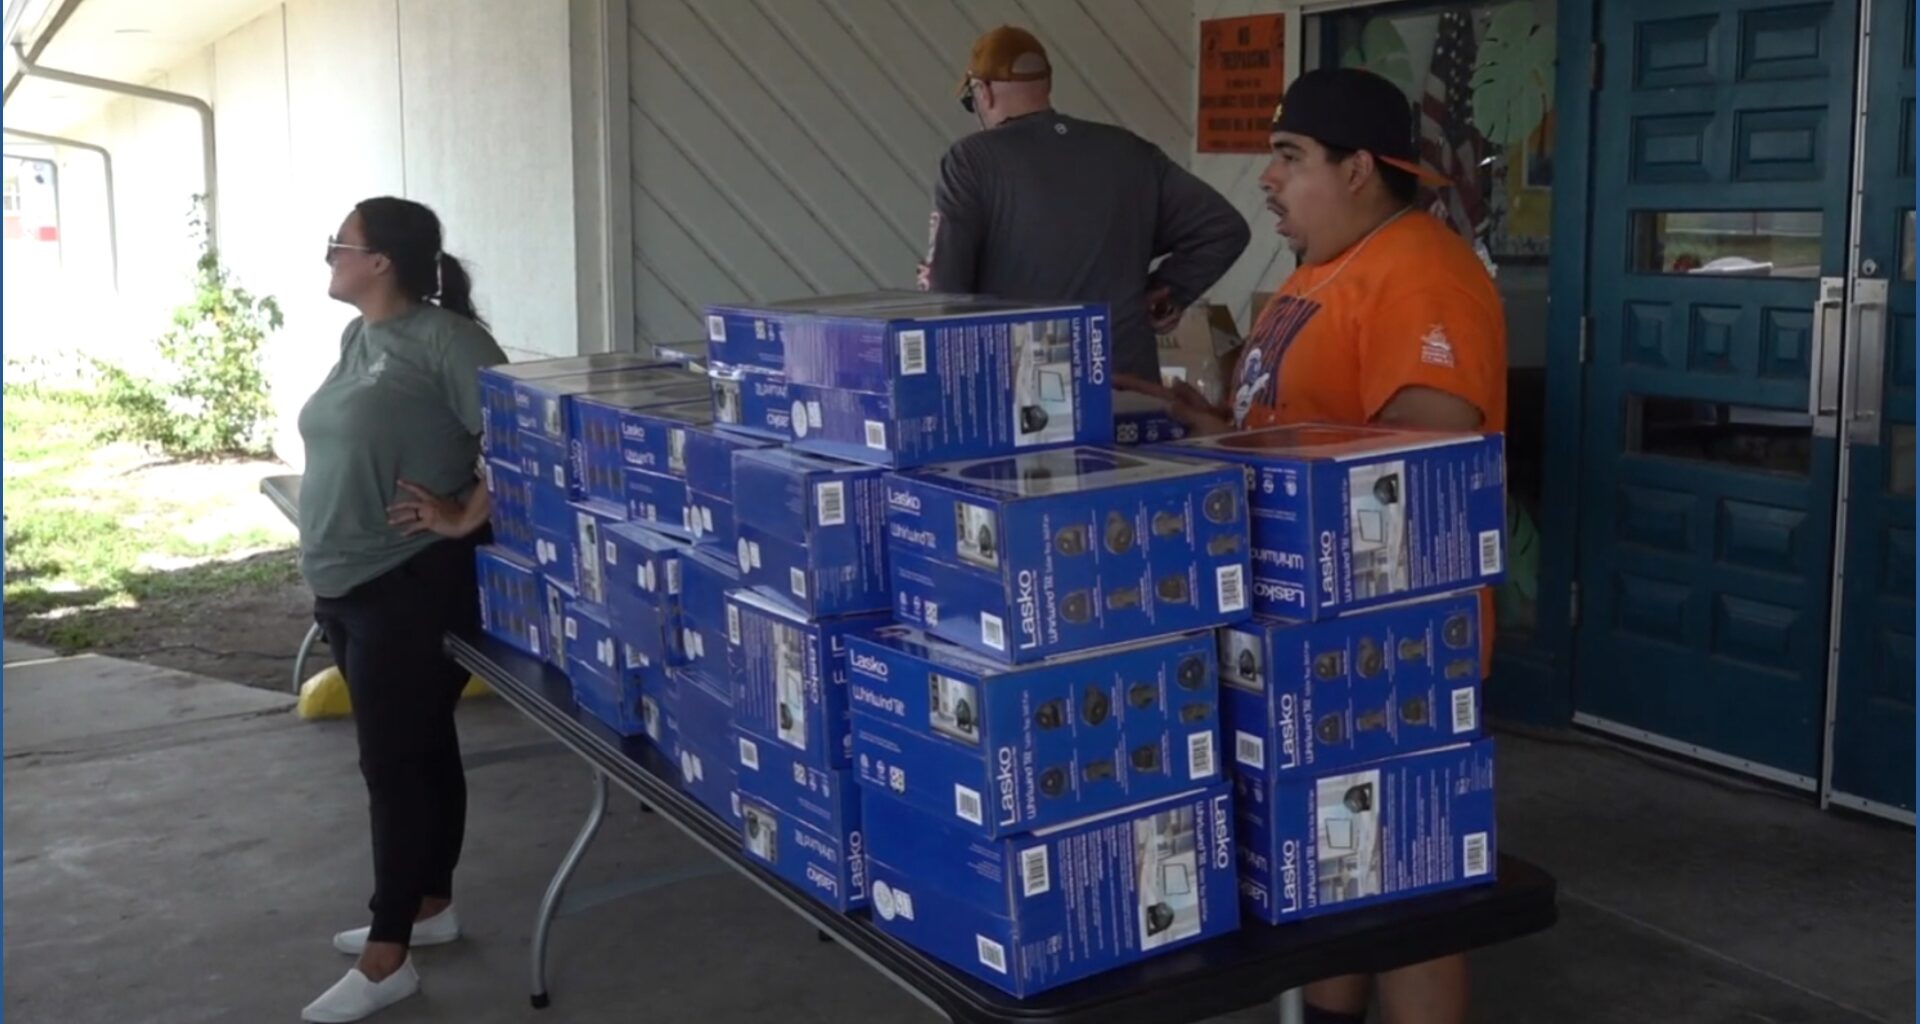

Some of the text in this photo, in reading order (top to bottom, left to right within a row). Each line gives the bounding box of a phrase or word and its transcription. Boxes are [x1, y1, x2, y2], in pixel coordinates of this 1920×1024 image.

[1090, 315, 1107, 386] Lasko
[887, 486, 921, 511] Lasko
[1253, 582, 1305, 609] Lasko
[1319, 530, 1334, 608] Lasko
[1017, 569, 1037, 649] Lasko
[850, 648, 889, 676] Lasko
[1279, 693, 1295, 769] Lasko
[996, 746, 1016, 827] Lasko
[848, 831, 865, 901] Lasko
[1213, 794, 1230, 870] Lasko
[806, 867, 838, 898] Lasko
[1281, 840, 1297, 913] Lasko
